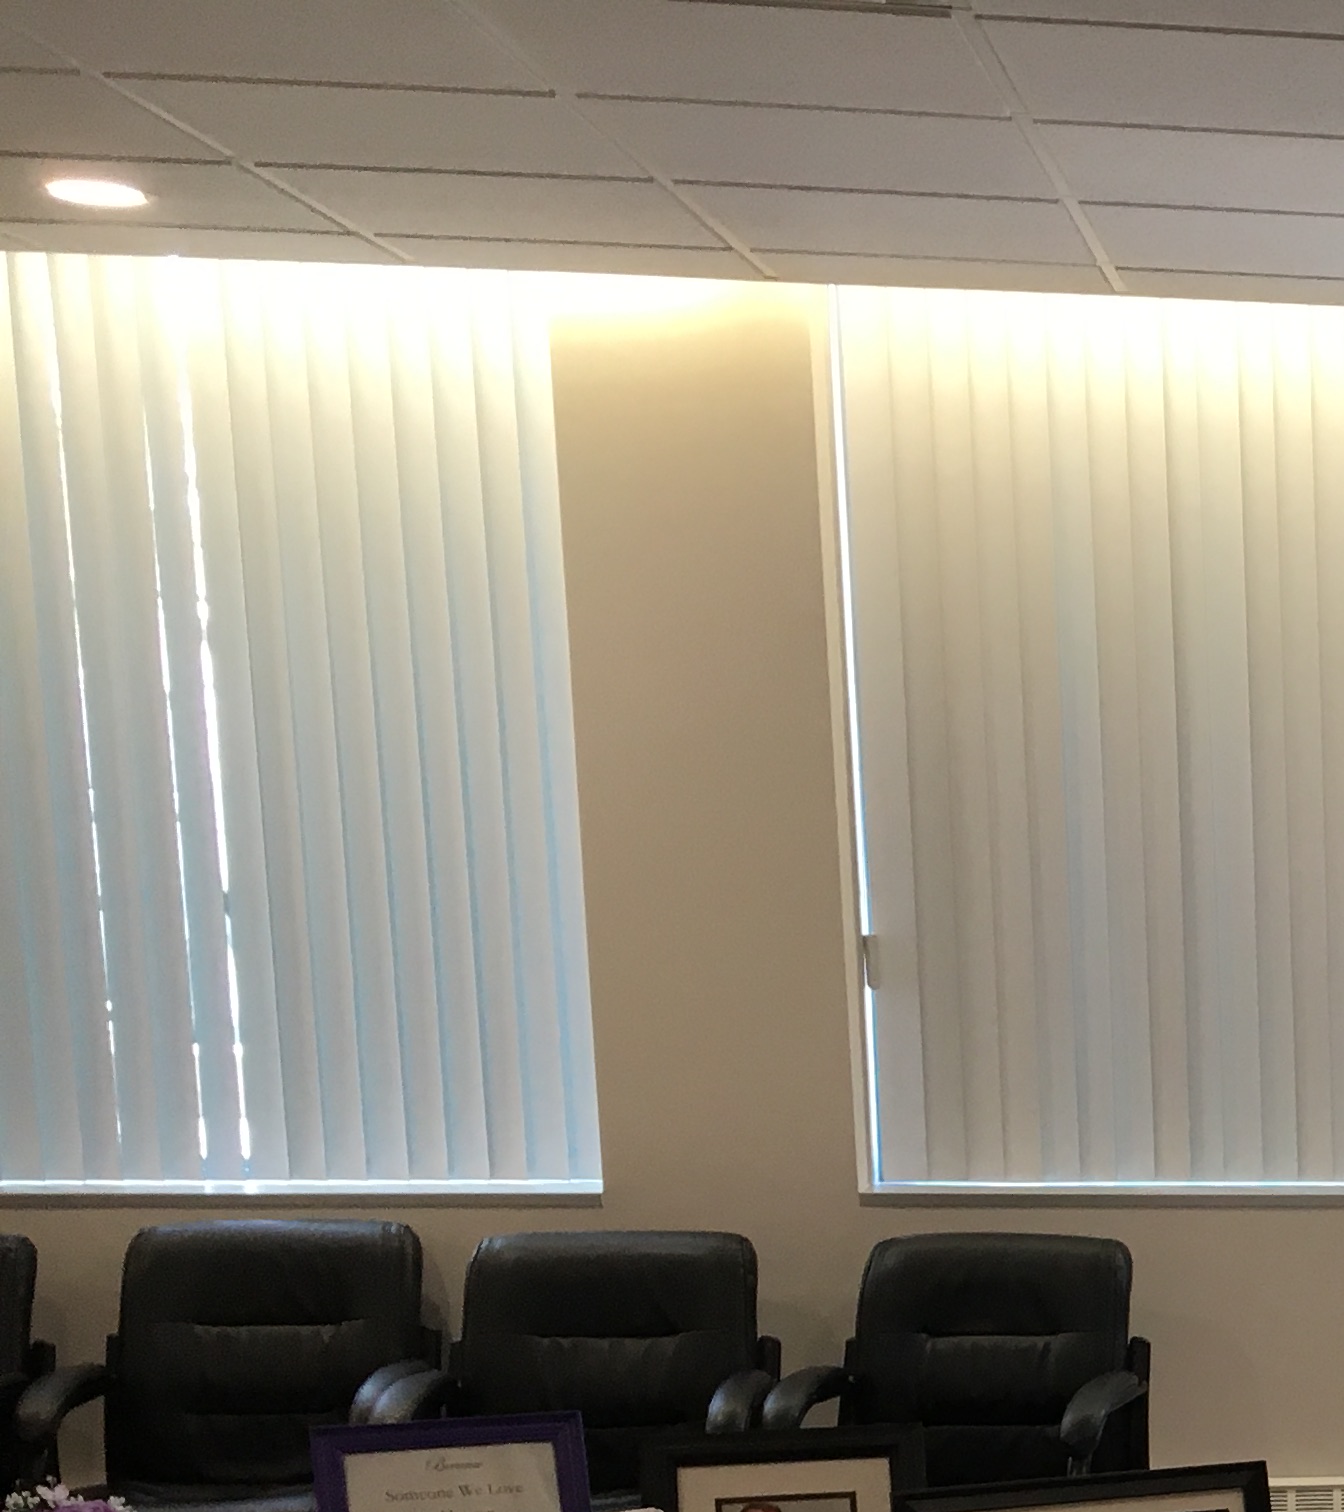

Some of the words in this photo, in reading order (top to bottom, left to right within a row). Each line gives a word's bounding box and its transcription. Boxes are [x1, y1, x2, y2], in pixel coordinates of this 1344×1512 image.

[385, 1489, 455, 1503] Someone
[458, 1485, 483, 1498] We
[487, 1483, 525, 1496] Love
